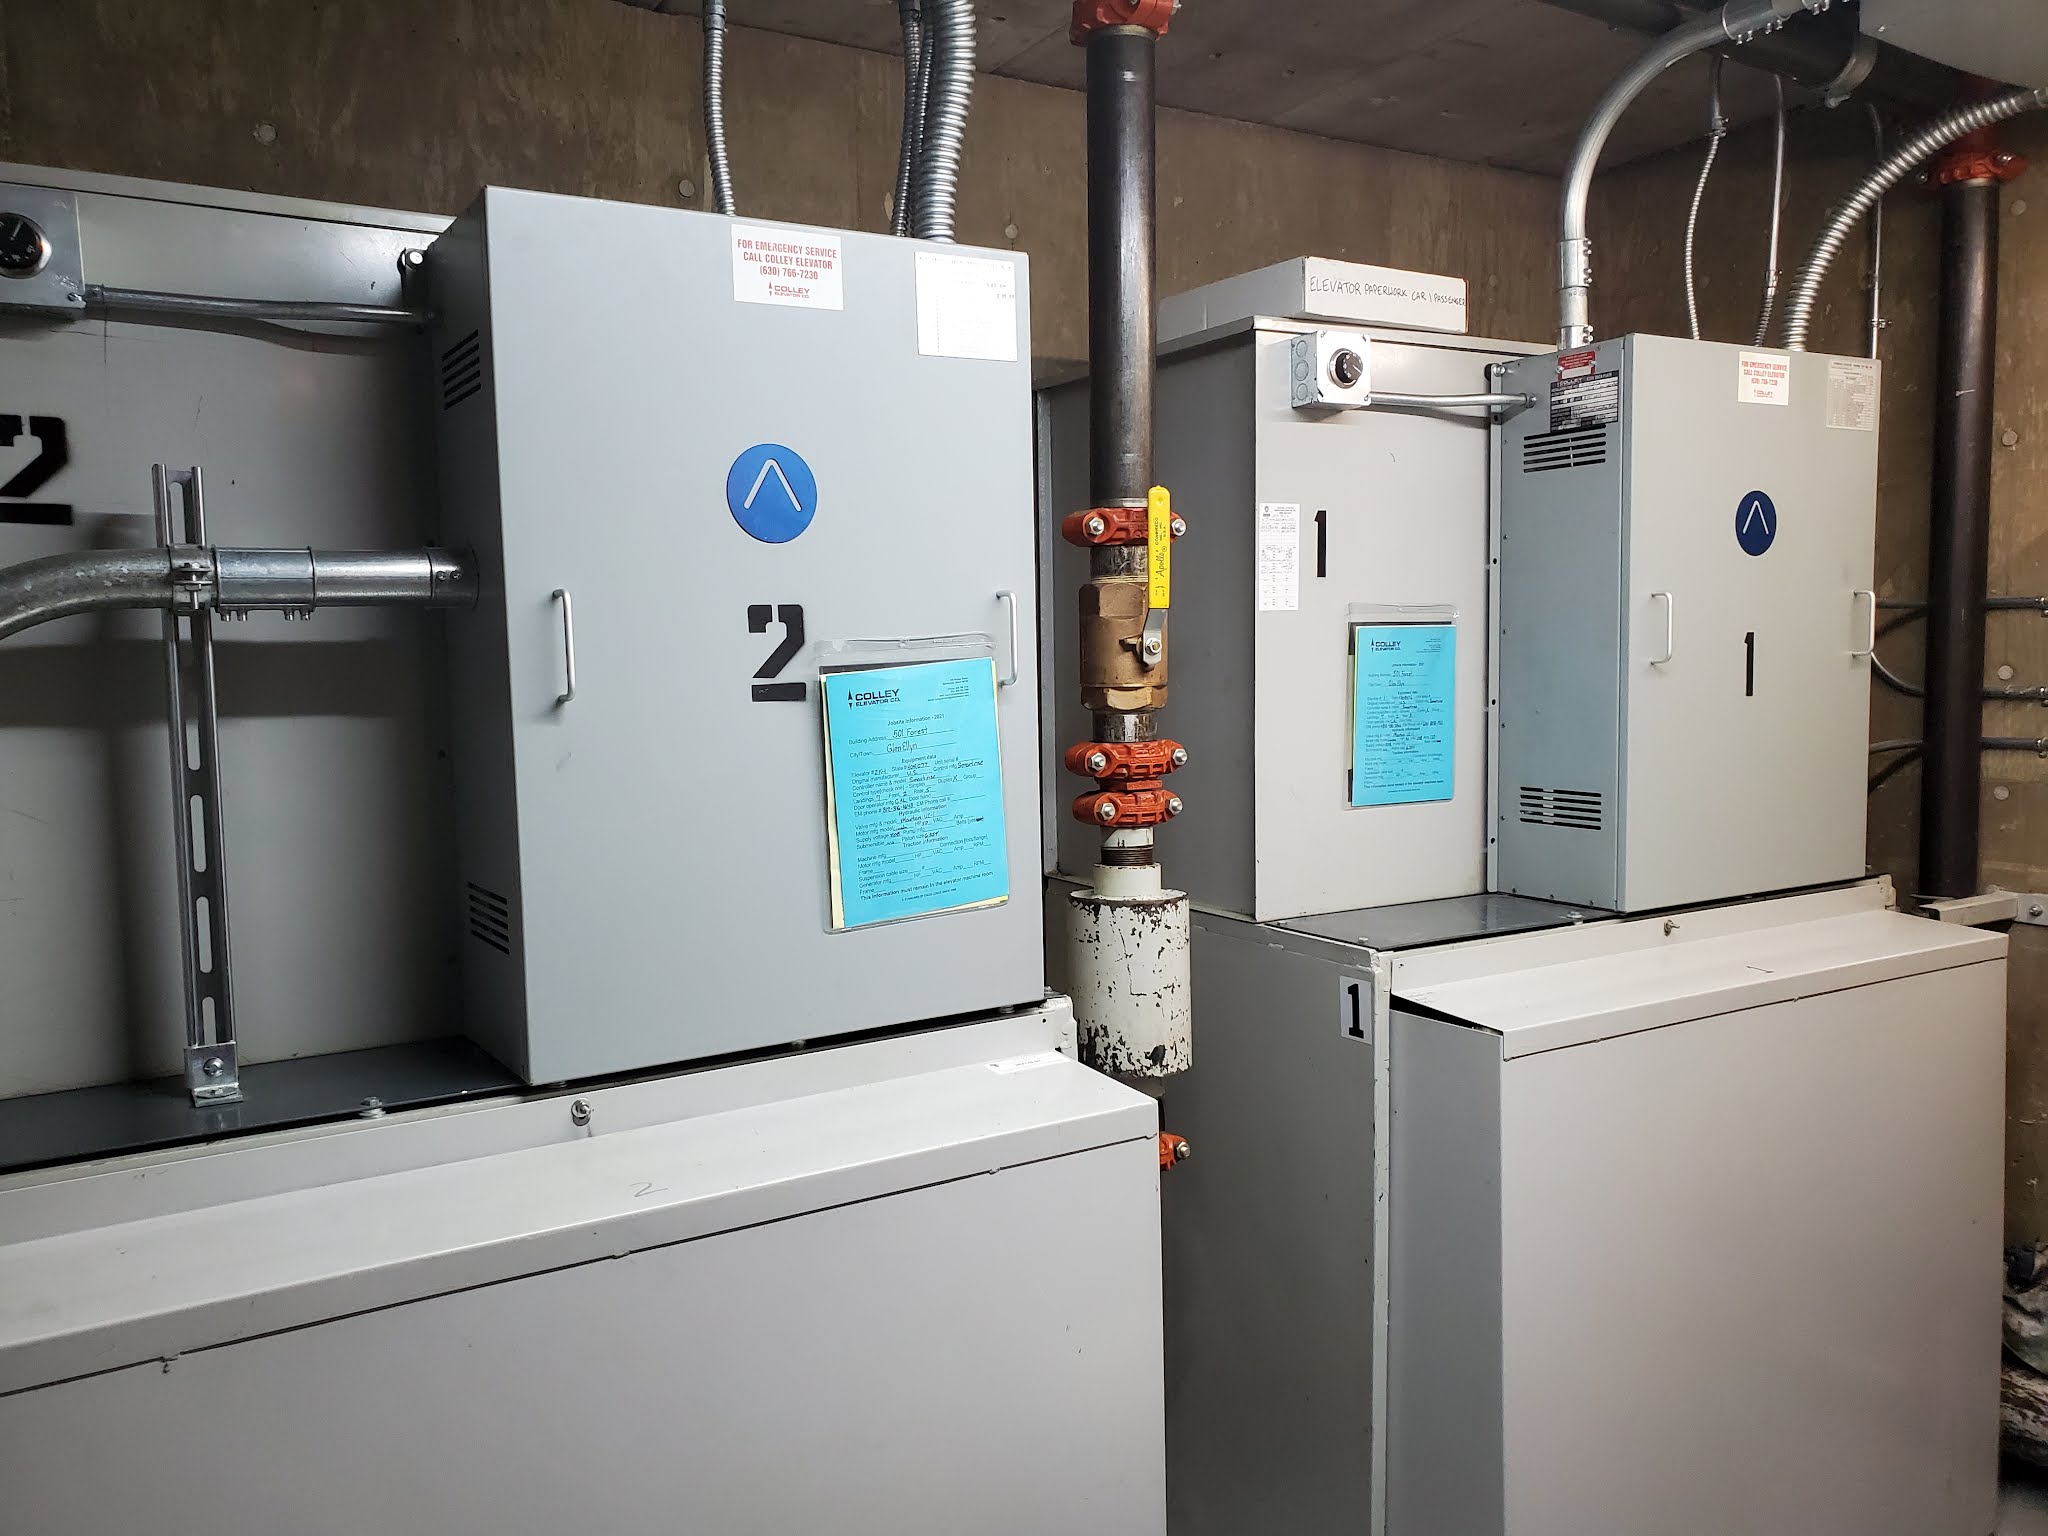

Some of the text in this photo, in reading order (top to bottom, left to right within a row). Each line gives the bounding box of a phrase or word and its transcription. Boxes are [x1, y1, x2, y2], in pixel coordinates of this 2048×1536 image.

[738, 239, 837, 258] FOR EMERGENCY SERVICE
[743, 252, 833, 269] CALL COLLEY ELEVATOR
[760, 265, 818, 279] (630) 766-7230
[774, 285, 810, 294] COLLEY
[1310, 276, 1362, 295] ELEVATOR
[1364, 283, 1407, 297] PAPERWORK
[1411, 291, 1426, 301] CAR
[1434, 293, 1466, 306] PASSENGER
[1749, 361, 1772, 369] EMERGENCY
[1772, 363, 1787, 371] SERVICE
[0, 414, 72, 526] 2
[1314, 510, 1326, 577] 1
[748, 604, 806, 702] 2
[1743, 632, 1754, 697] 1
[855, 689, 900, 701] COLLEY
[855, 699, 889, 707] ELEVATOR
[905, 715, 930, 724] Information
[848, 737, 867, 746] Building
[892, 730, 903, 738] 501
[906, 726, 927, 736] Forest
[886, 742, 901, 754] Glen
[902, 739, 918, 755] Ellyn
[901, 756, 926, 764] Equipment
[851, 777, 869, 785] Original
[870, 773, 899, 782] manufacturer
[852, 783, 874, 791] Controller
[852, 790, 869, 798] Control
[853, 797, 874, 805] Landings
[866, 801, 885, 809] operator
[898, 804, 947, 816] Hydraulic Information
[903, 840, 922, 848] Traction
[857, 855, 876, 863] Machine
[858, 873, 885, 882] Suspension
[859, 879, 881, 888] Generator
[912, 883, 929, 891] remain
[943, 877, 962, 885] elevator
[962, 873, 980, 882] machine
[859, 887, 874, 895] Frame
[1347, 983, 1364, 1039] 1
[628, 1182, 668, 1197] 2
